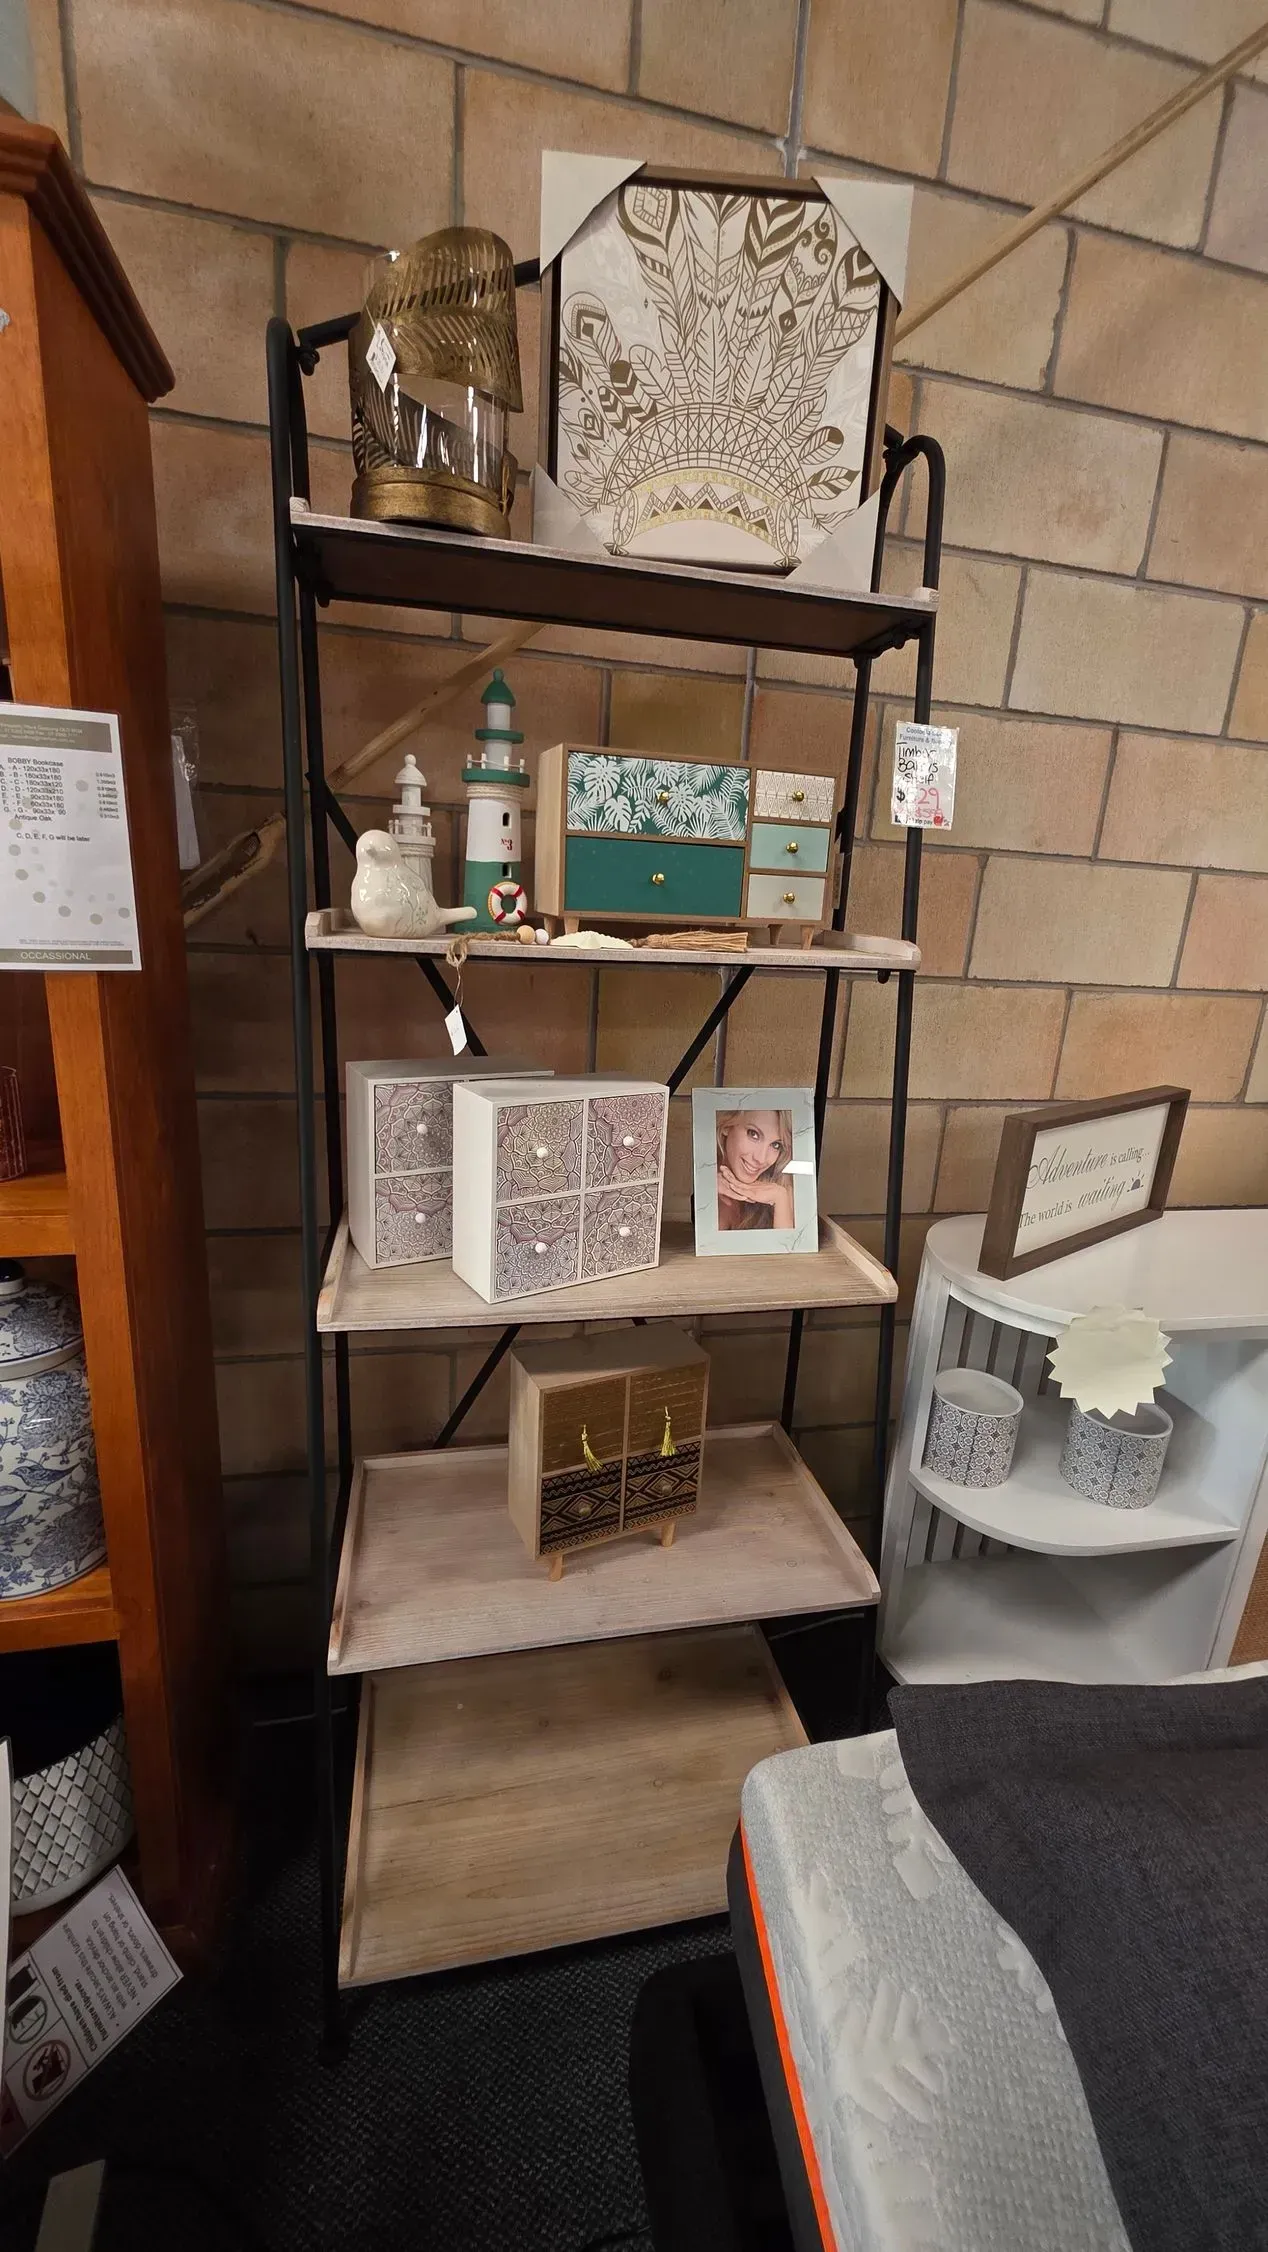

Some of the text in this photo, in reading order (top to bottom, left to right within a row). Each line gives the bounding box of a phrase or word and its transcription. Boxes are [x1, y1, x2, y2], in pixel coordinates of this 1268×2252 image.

[897, 742, 936, 761] Timbr
[33, 759, 63, 767] Bookcase
[20, 952, 92, 960] OCCASSIONAL
[1026, 1144, 1108, 1189] Adventure
[1110, 1154, 1117, 1166] is
[1018, 1176, 1126, 1228] The world is waiting
[102, 1912, 111, 1922] on
[122, 1920, 129, 1928] or
[108, 1921, 120, 1941] hang
[117, 1940, 125, 1948] or
[78, 1952, 88, 1968] this
[91, 1919, 137, 2000] NEVER allow children to
[122, 1947, 136, 1966] climb
[52, 1966, 64, 1987] from
[97, 1960, 114, 1984] anchor
[59, 1984, 72, 2002] died
[110, 1982, 119, 1993] an
[96, 1988, 116, 2020] ALWAYS
[116, 1992, 127, 2009] with
[70, 2001, 83, 2022] have
[88, 2006, 109, 2041] furniture
